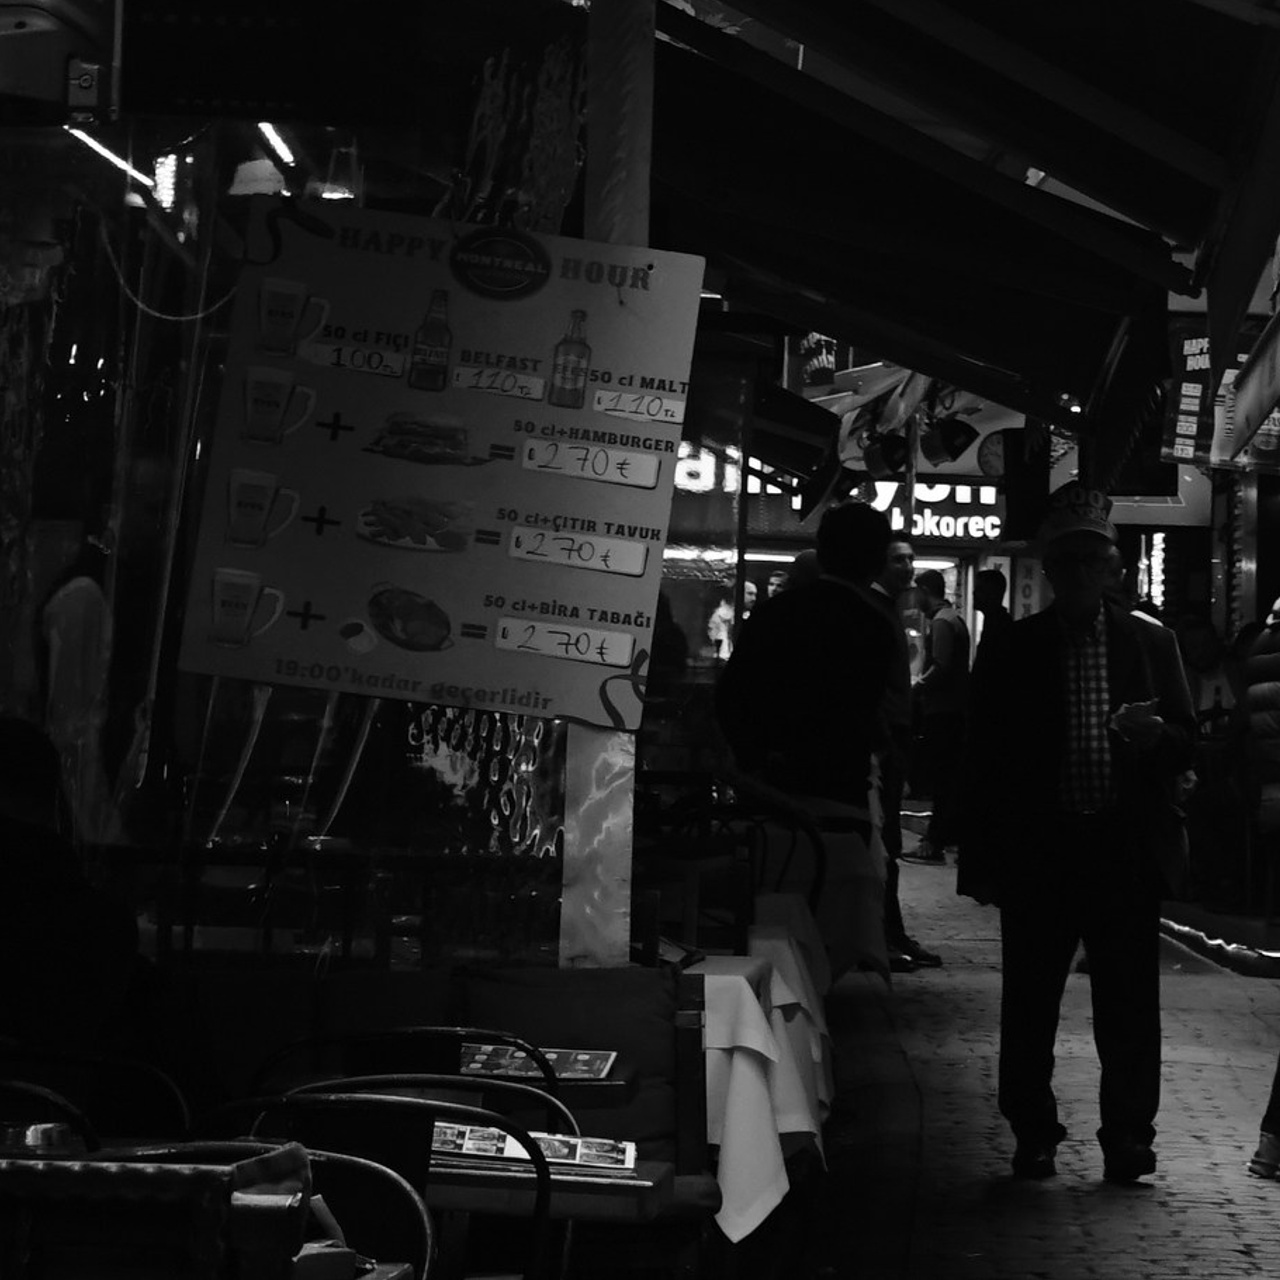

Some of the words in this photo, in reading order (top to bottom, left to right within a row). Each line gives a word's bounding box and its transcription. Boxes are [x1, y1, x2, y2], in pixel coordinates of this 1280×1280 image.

[336, 226, 447, 262] HAPPY
[560, 257, 650, 291] HOUR
[454, 251, 549, 275] MONTREAL
[322, 324, 347, 340] 50
[352, 329, 369, 343] cl
[374, 331, 410, 353] FIÇI
[460, 349, 544, 372] BELFAST
[589, 369, 613, 385] 50
[618, 374, 633, 387] cl
[639, 376, 689, 394] MALT
[513, 419, 536, 434] 50
[496, 507, 519, 522] 50
[604, 521, 662, 542] TAVUK
[482, 594, 506, 609] 50
[587, 607, 651, 629] TABAĞI
[430, 680, 554, 712] geçerlidir
